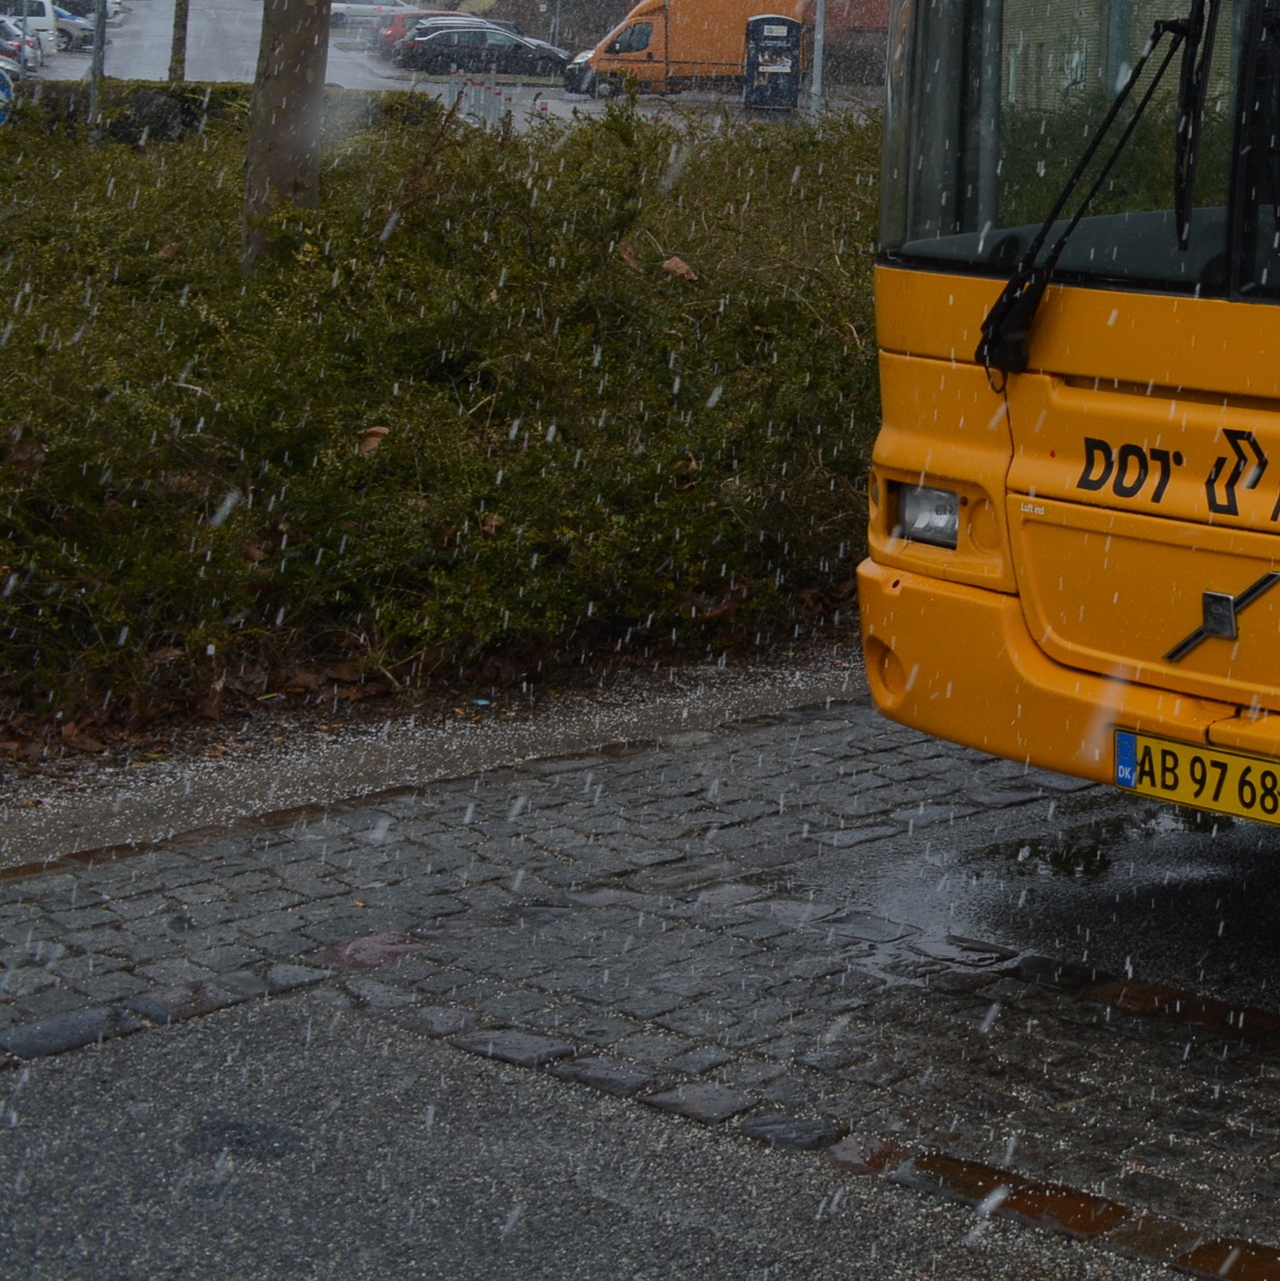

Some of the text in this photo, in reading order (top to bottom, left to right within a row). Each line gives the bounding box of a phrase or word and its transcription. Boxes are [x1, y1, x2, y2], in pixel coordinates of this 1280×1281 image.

[1076, 437, 1173, 503] DOT
[1118, 765, 1131, 779] DK
[1138, 745, 1179, 792] AB
[1189, 756, 1228, 802] 97
